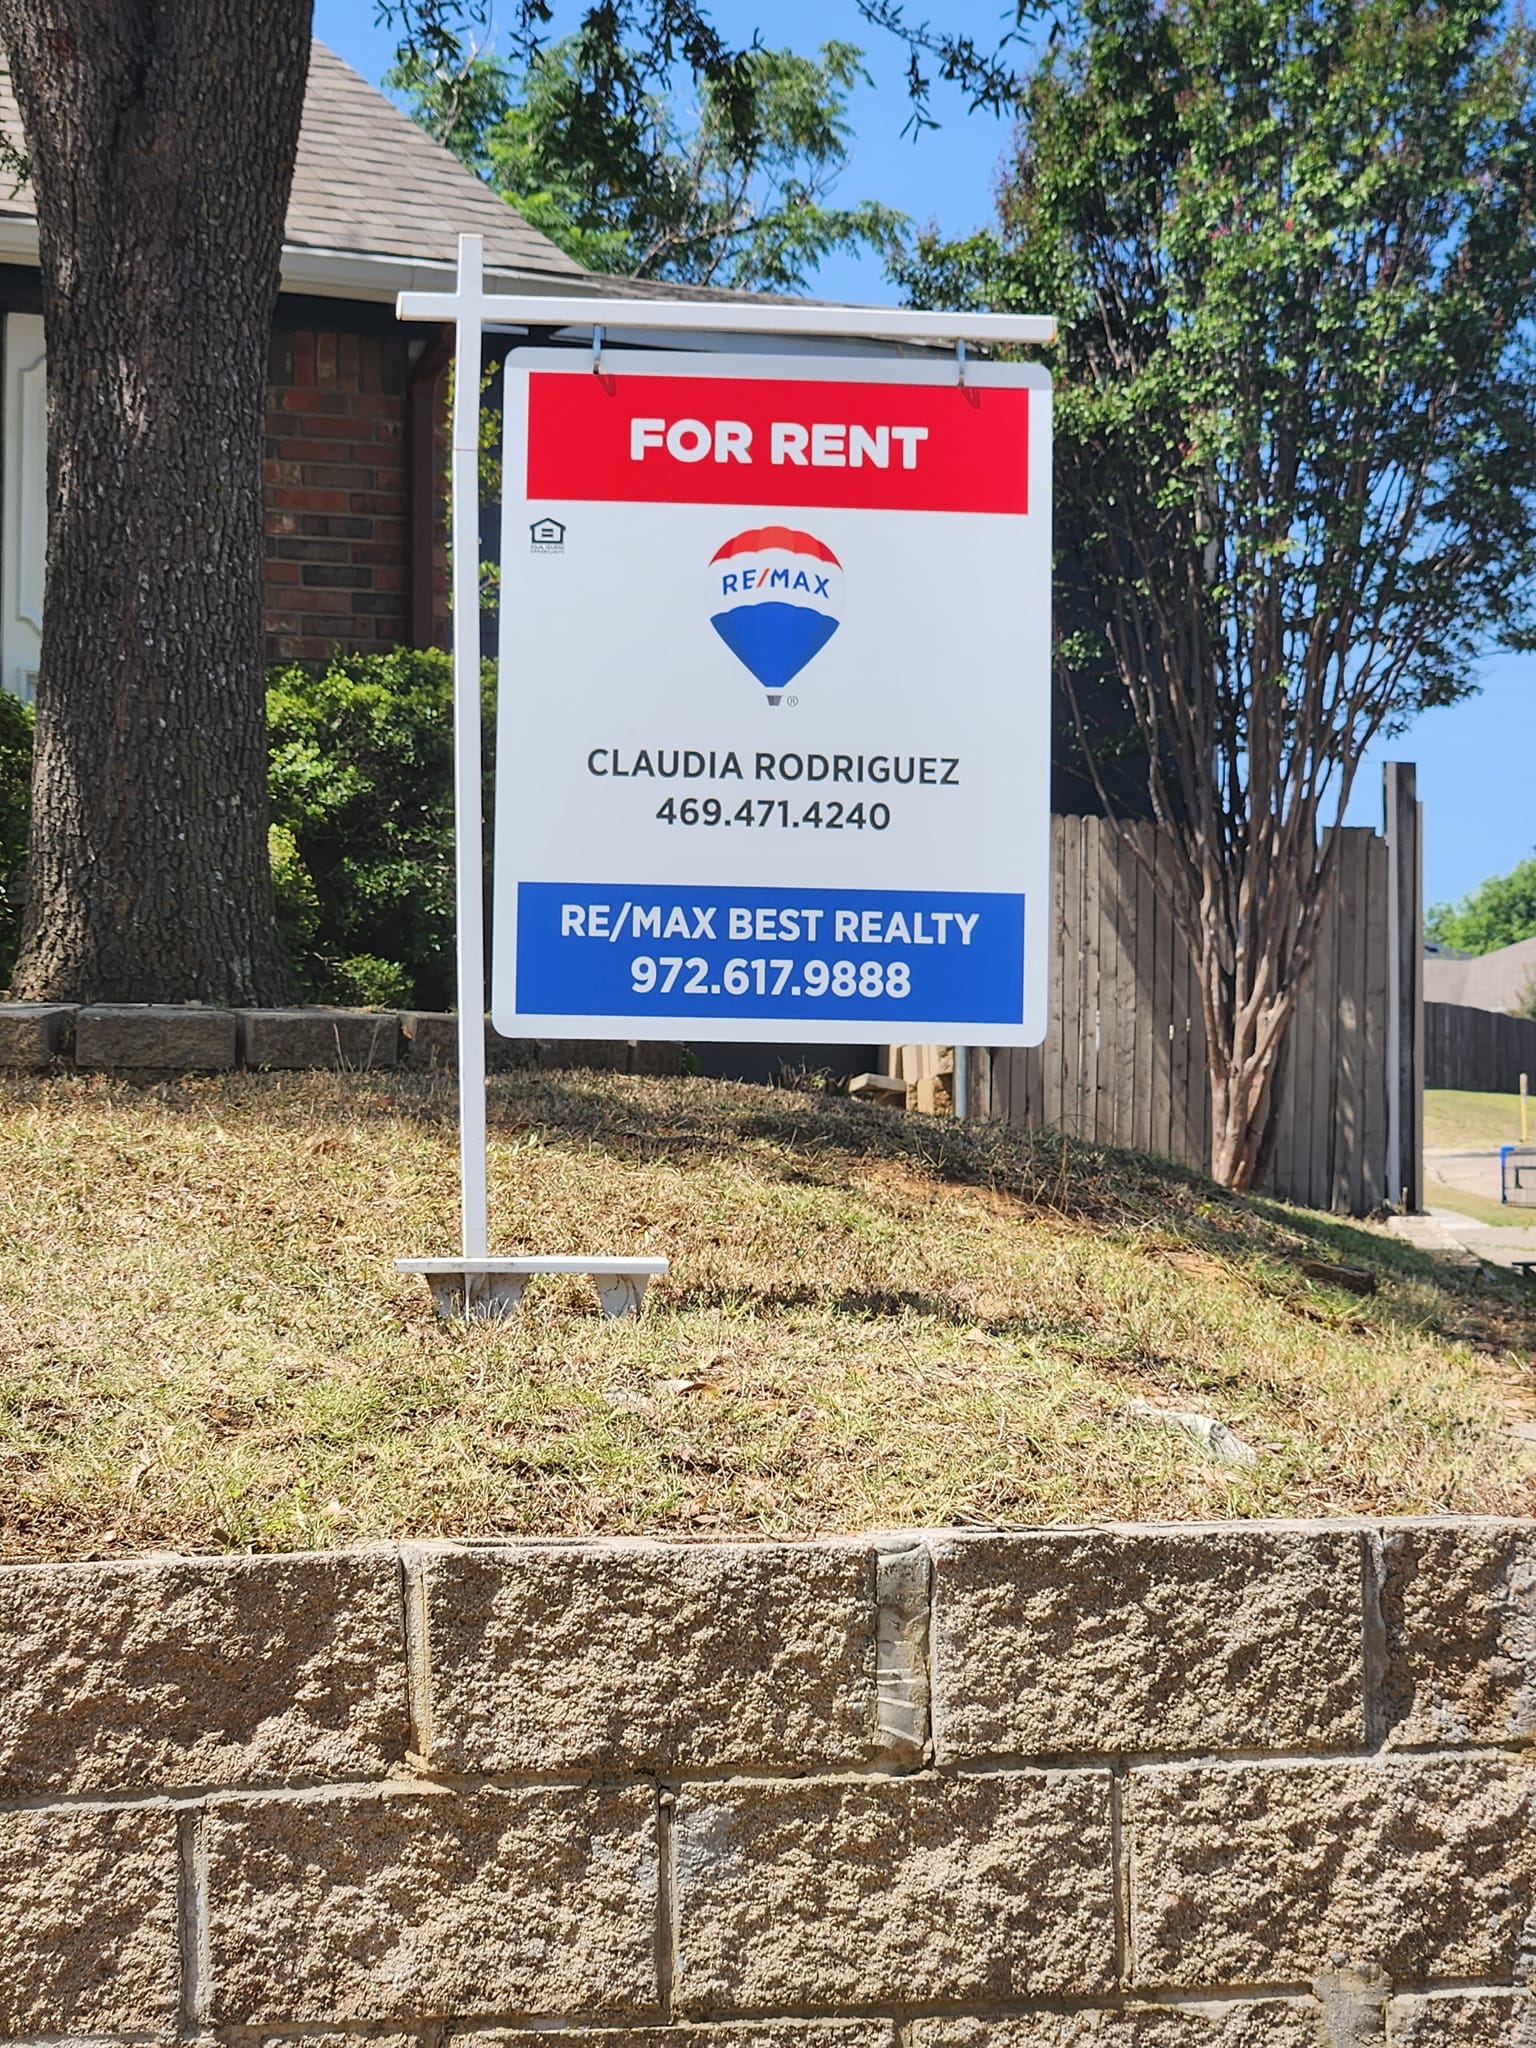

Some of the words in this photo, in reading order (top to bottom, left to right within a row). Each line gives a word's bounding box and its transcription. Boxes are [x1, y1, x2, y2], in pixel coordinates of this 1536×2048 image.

[630, 417, 753, 464] FOR
[770, 422, 929, 470] RENT
[722, 568, 830, 599] RE/MAX
[587, 748, 744, 780] CLAUDIA
[755, 752, 960, 785] RODRIGUEZ
[655, 797, 891, 831] 469.471.4240
[561, 903, 717, 943] RE/MAX
[729, 908, 824, 943] BEST
[835, 910, 980, 946] REALTY
[631, 956, 911, 999] 972.617.9888
